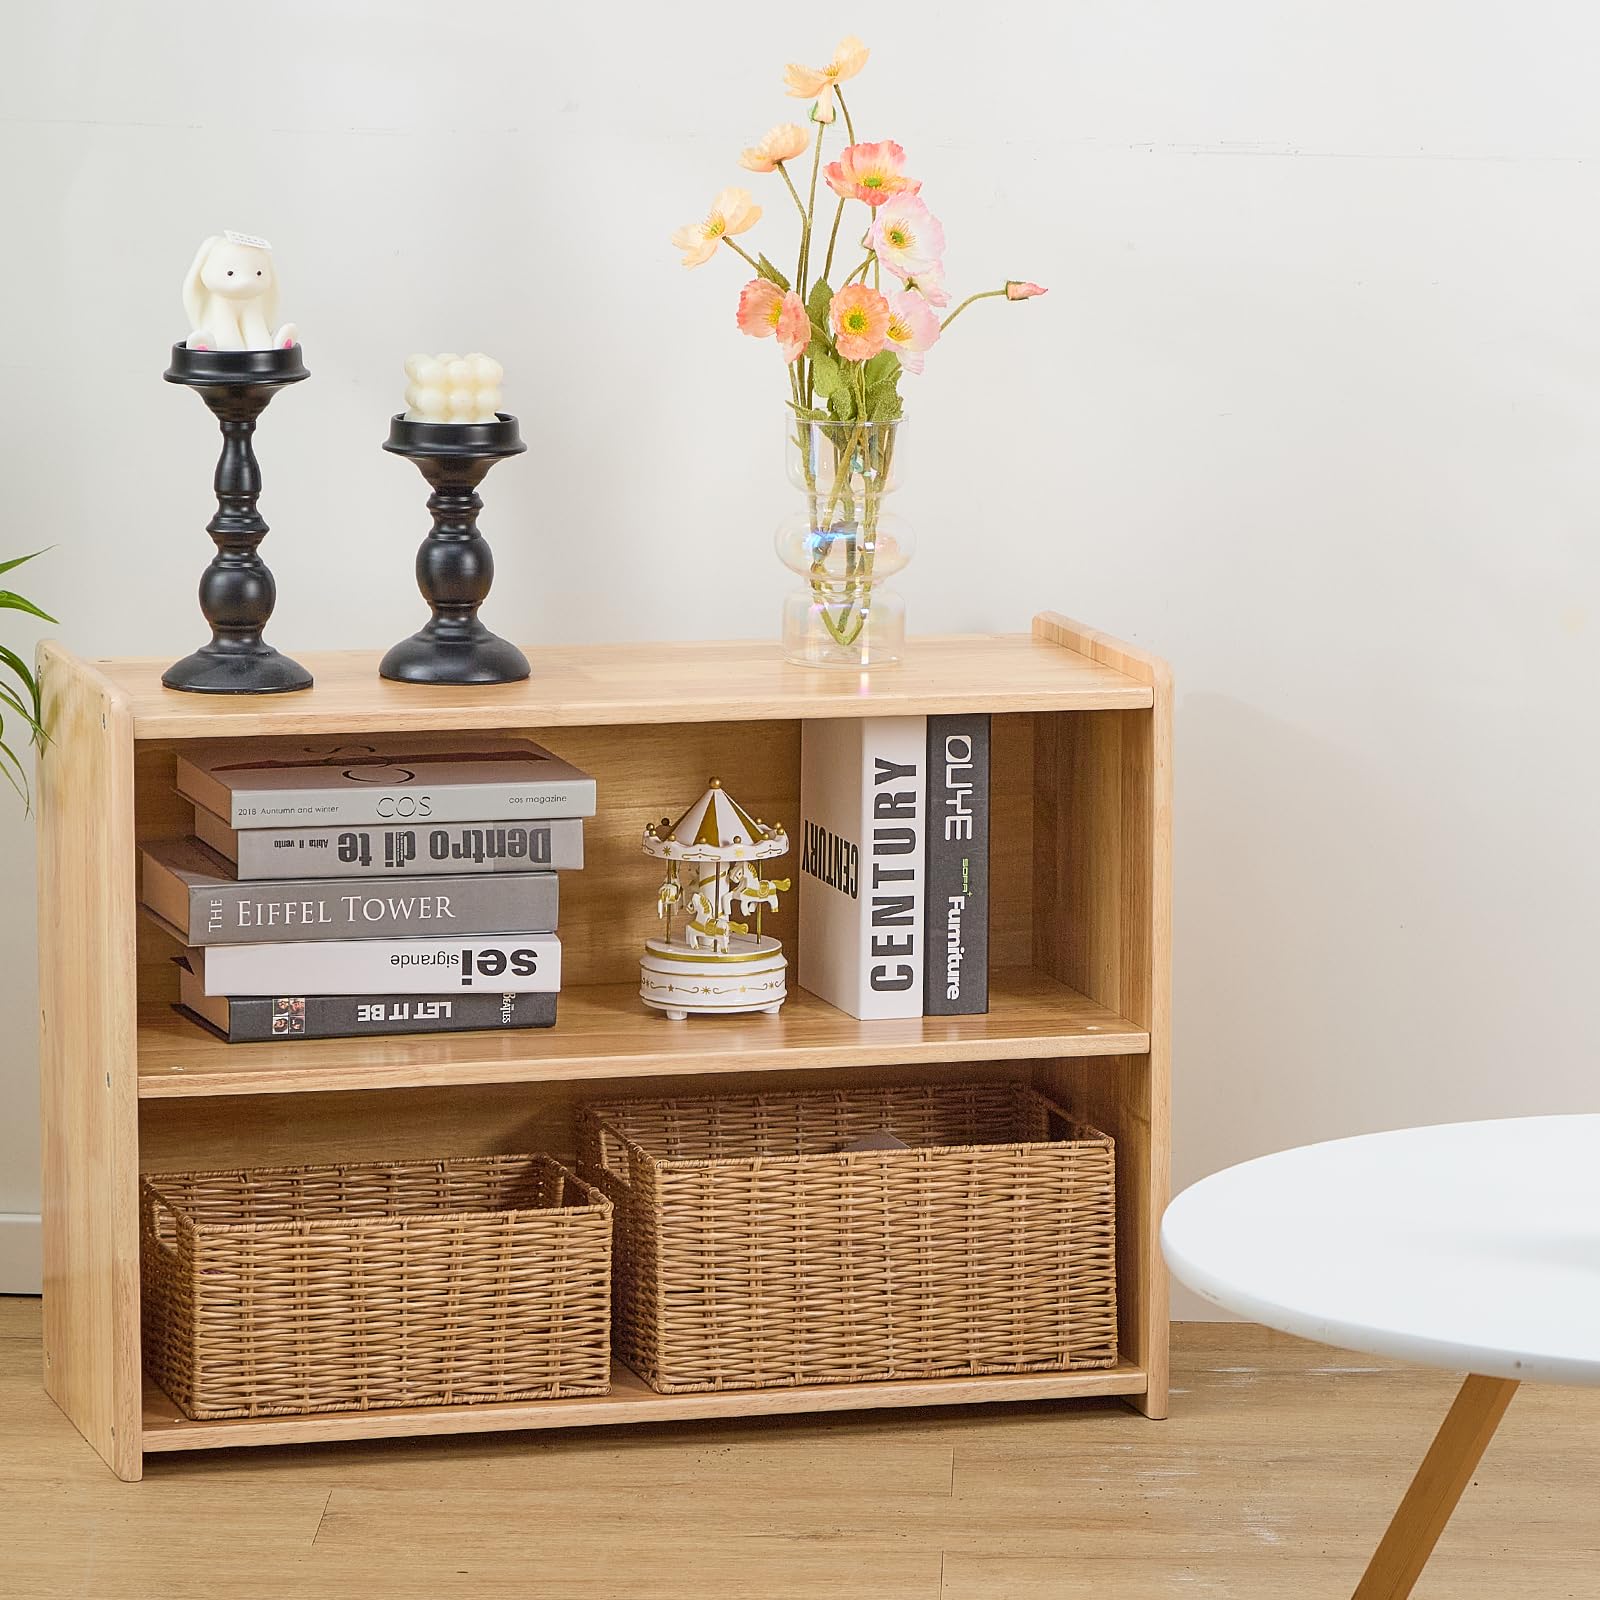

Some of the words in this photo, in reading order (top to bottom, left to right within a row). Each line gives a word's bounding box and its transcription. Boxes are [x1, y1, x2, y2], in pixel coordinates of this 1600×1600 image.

[238, 808, 257, 816] 2018
[297, 806, 313, 814] and
[315, 805, 340, 813] winter
[376, 796, 432, 818] COS
[508, 796, 524, 804] cos
[525, 794, 567, 805] magazine
[274, 839, 295, 849] vento
[308, 839, 329, 849] Abita
[337, 832, 373, 867] te
[384, 830, 417, 868] di
[429, 828, 552, 864] Dentro
[801, 819, 859, 900] CENTURY
[870, 757, 917, 992] CENTURY
[208, 899, 223, 932] THE
[236, 900, 332, 927] EIFFEL
[341, 895, 457, 923] TOWER
[946, 896, 966, 1001] Furniture
[390, 951, 460, 969] sigrande
[461, 949, 538, 986] sei
[357, 1003, 386, 1022] BE
[388, 1002, 410, 1021] IT
[413, 1001, 452, 1020] LET
